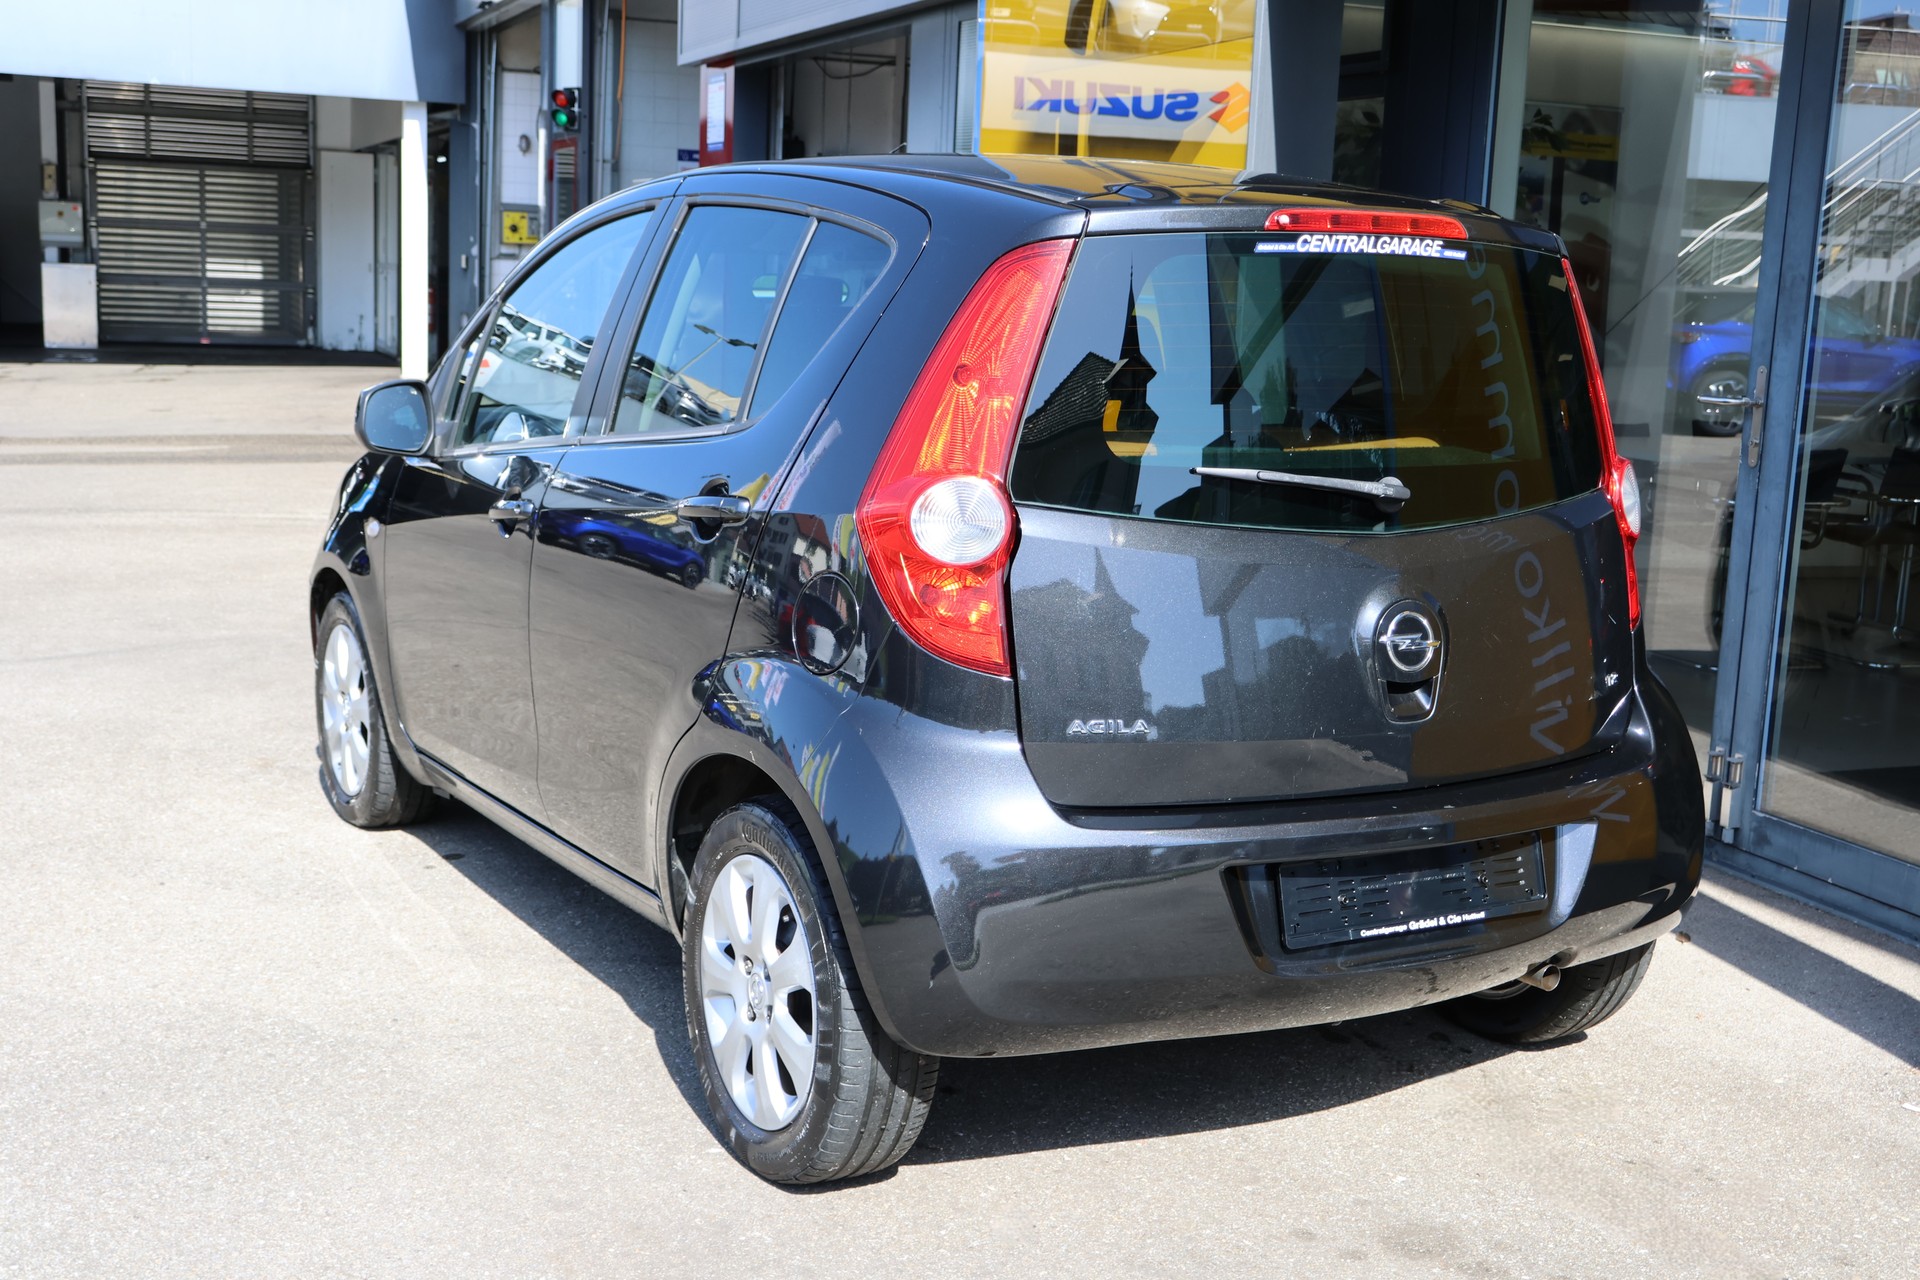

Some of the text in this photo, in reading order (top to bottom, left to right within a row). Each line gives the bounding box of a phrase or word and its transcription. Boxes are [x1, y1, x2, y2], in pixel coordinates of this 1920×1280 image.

[1296, 234, 1444, 257] CENTRALGARAGE
[1066, 719, 1151, 736] AGILA
[1439, 917, 1447, 926] &
[1447, 914, 1462, 924] Cie
